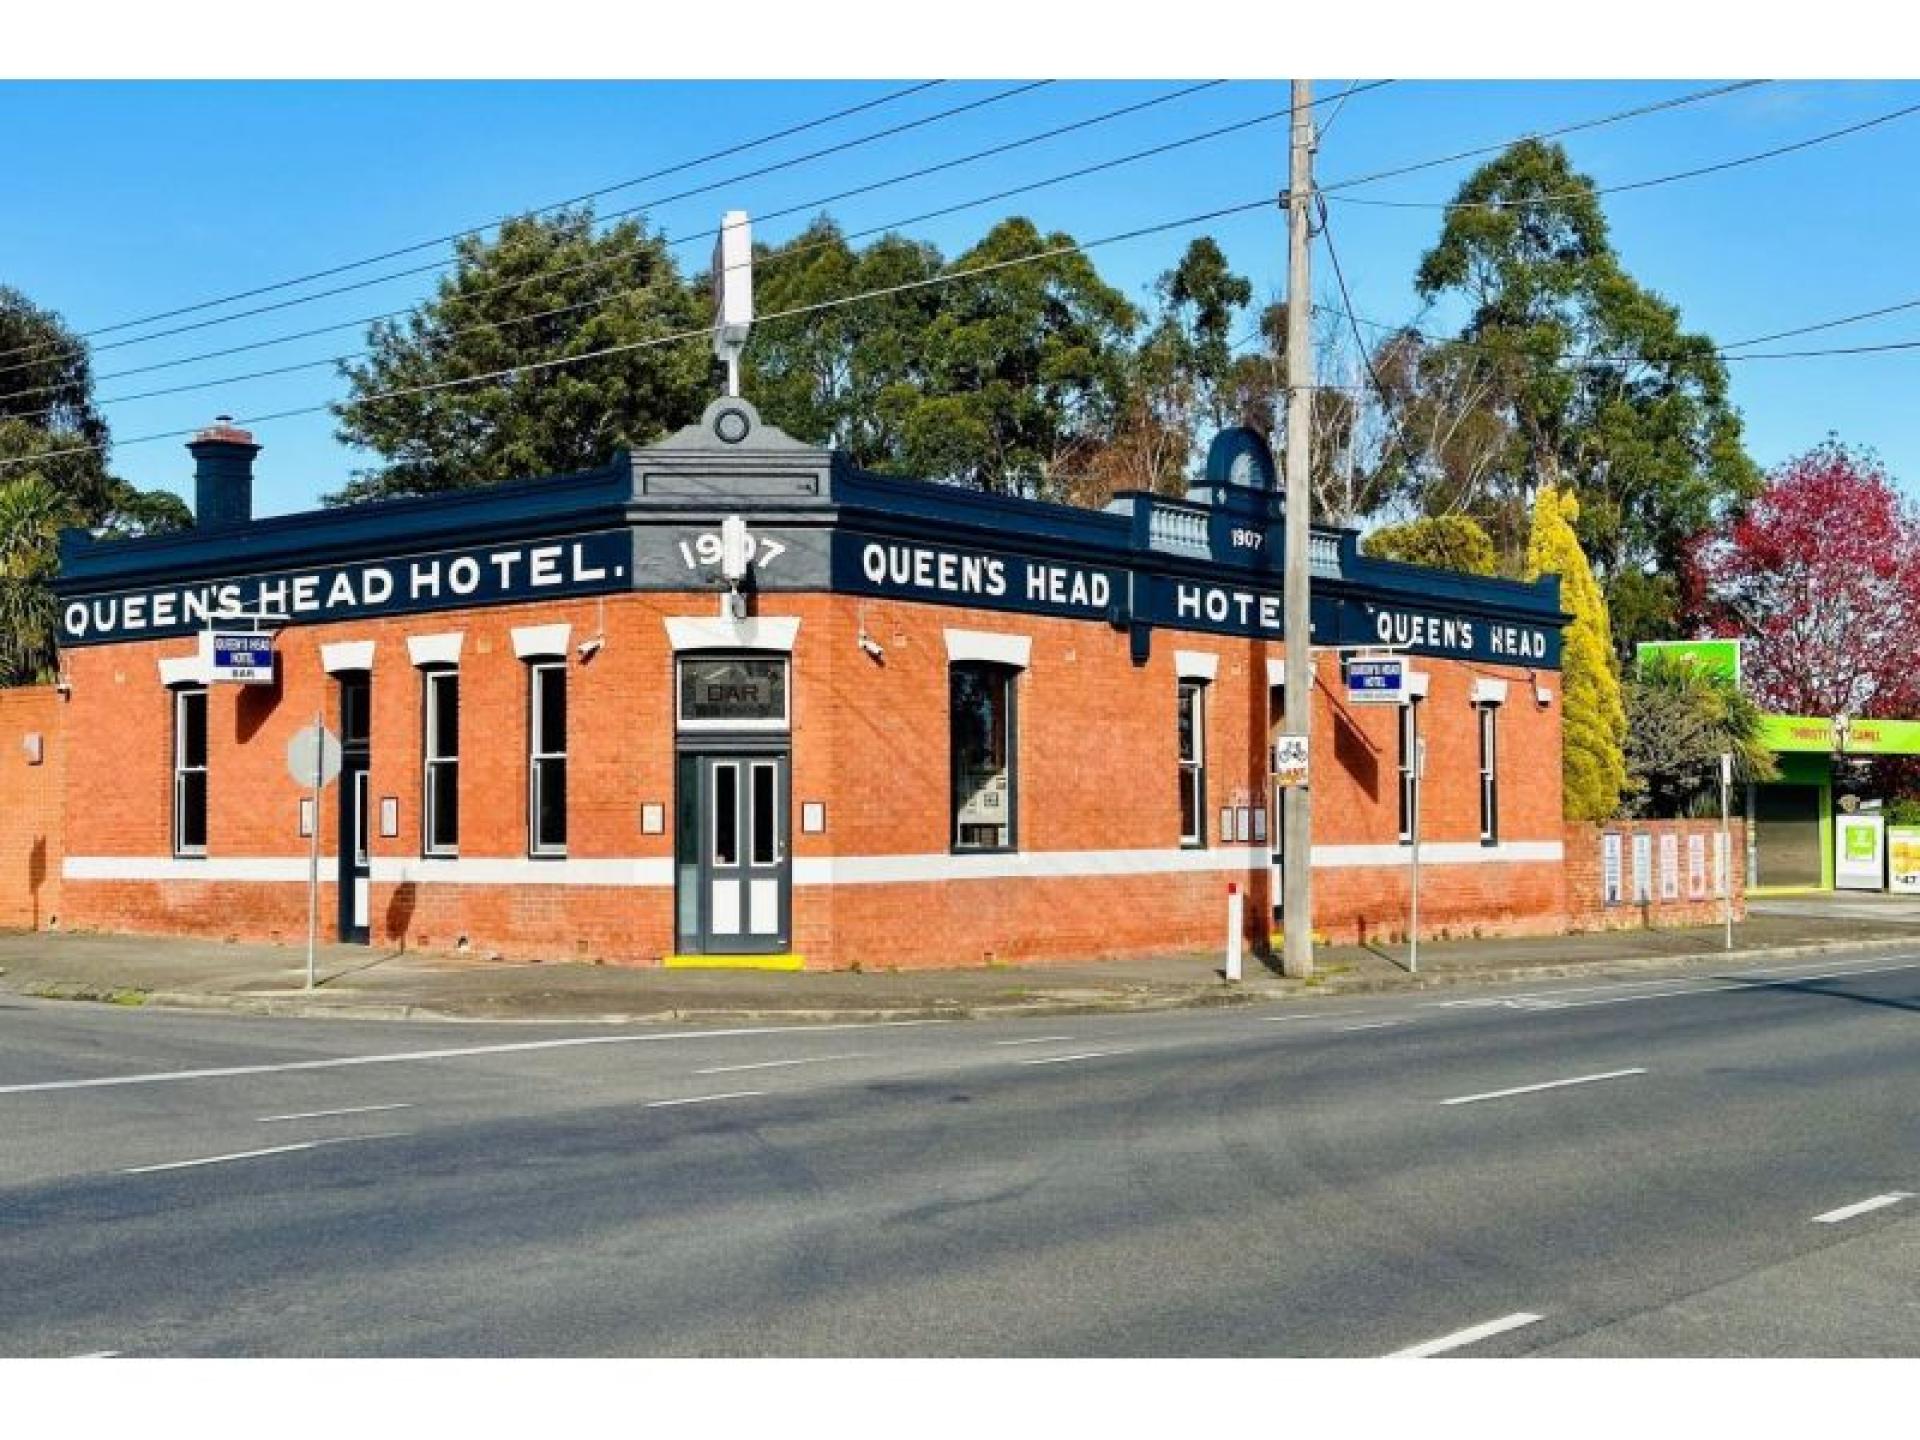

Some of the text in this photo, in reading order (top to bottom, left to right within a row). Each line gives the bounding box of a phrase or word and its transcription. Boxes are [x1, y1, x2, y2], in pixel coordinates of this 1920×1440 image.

[64, 544, 624, 637] QUEEN'S HEAD HOTEL.
[863, 543, 1110, 608] QUEEN'S HEAD
[1177, 585, 1316, 632] HOTE.
[1377, 611, 1547, 659] QUEEN'S HEAD
